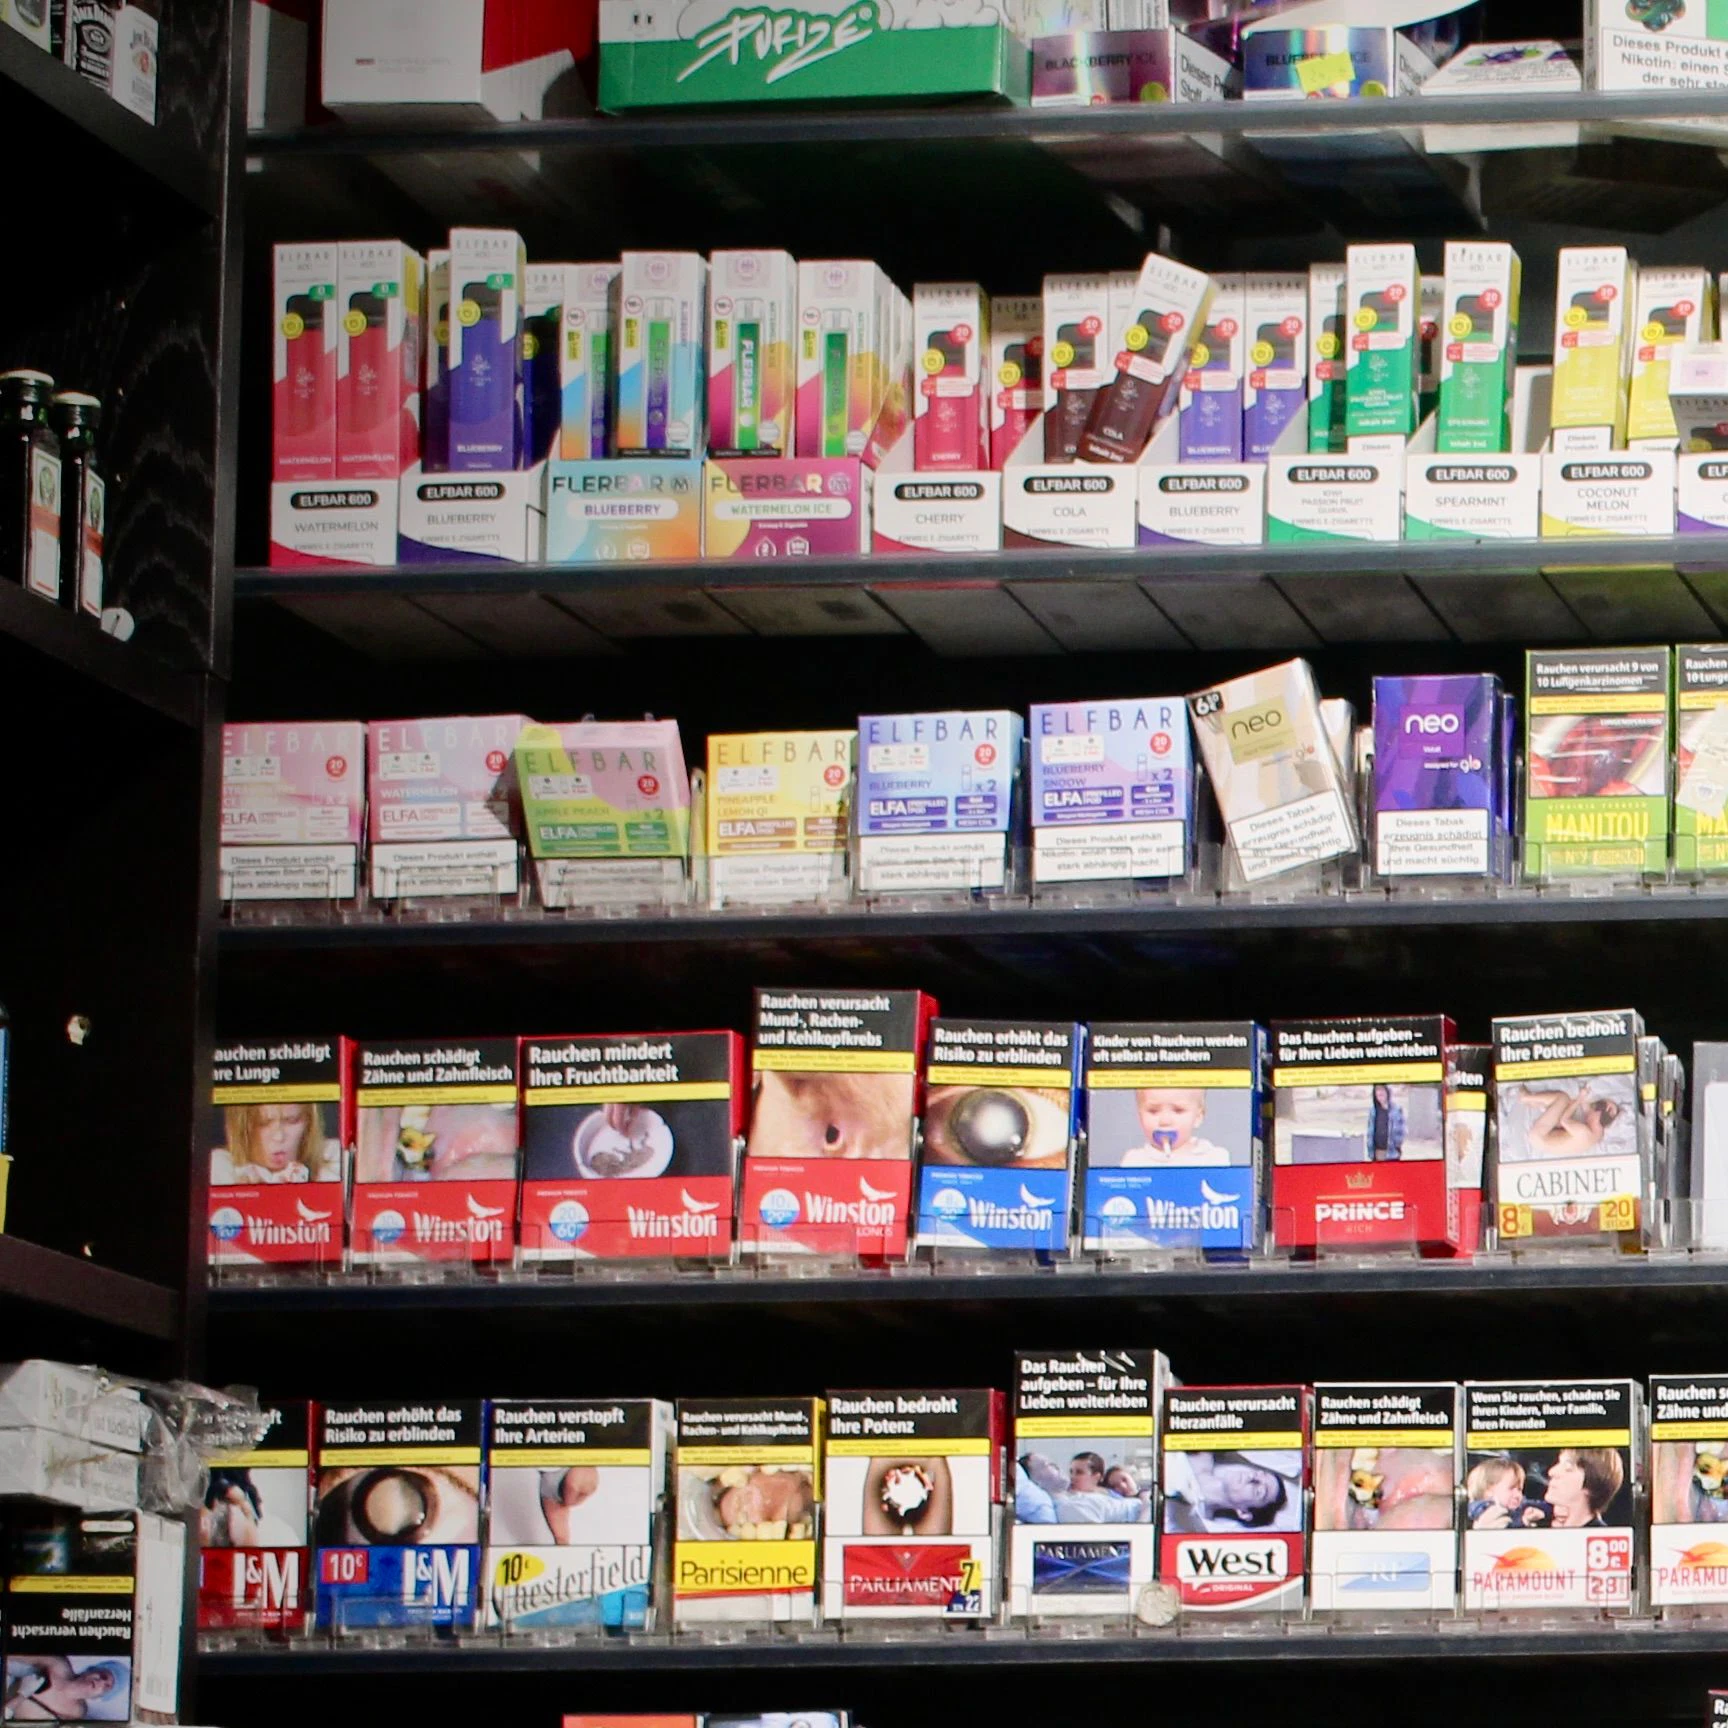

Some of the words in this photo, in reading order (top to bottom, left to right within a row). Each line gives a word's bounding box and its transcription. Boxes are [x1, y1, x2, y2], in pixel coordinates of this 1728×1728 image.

[1033, 477, 1078, 492] ELFBAR
[1082, 477, 1107, 492] 600
[300, 492, 344, 507] ELFBAR
[348, 492, 372, 507] 600
[584, 502, 661, 516] BLUEBERRY
[1435, 495, 1507, 508] SPEARMINT
[915, 512, 965, 526] CHERRY
[1169, 504, 1241, 519] BLUEBERRY
[295, 519, 379, 534] WATERMELON
[869, 716, 998, 744] ELFBAR
[1231, 708, 1282, 740] neo
[1405, 711, 1458, 734] neo
[1516, 1167, 1622, 1198] CABINET
[806, 1192, 895, 1225] Winston
[1149, 1196, 1239, 1230] Winston
[1315, 1202, 1405, 1223] PRINCE
[680, 1560, 808, 1586] Parisienne
[1187, 1547, 1277, 1579] West
[849, 1575, 961, 1593] PARLIAMENT
